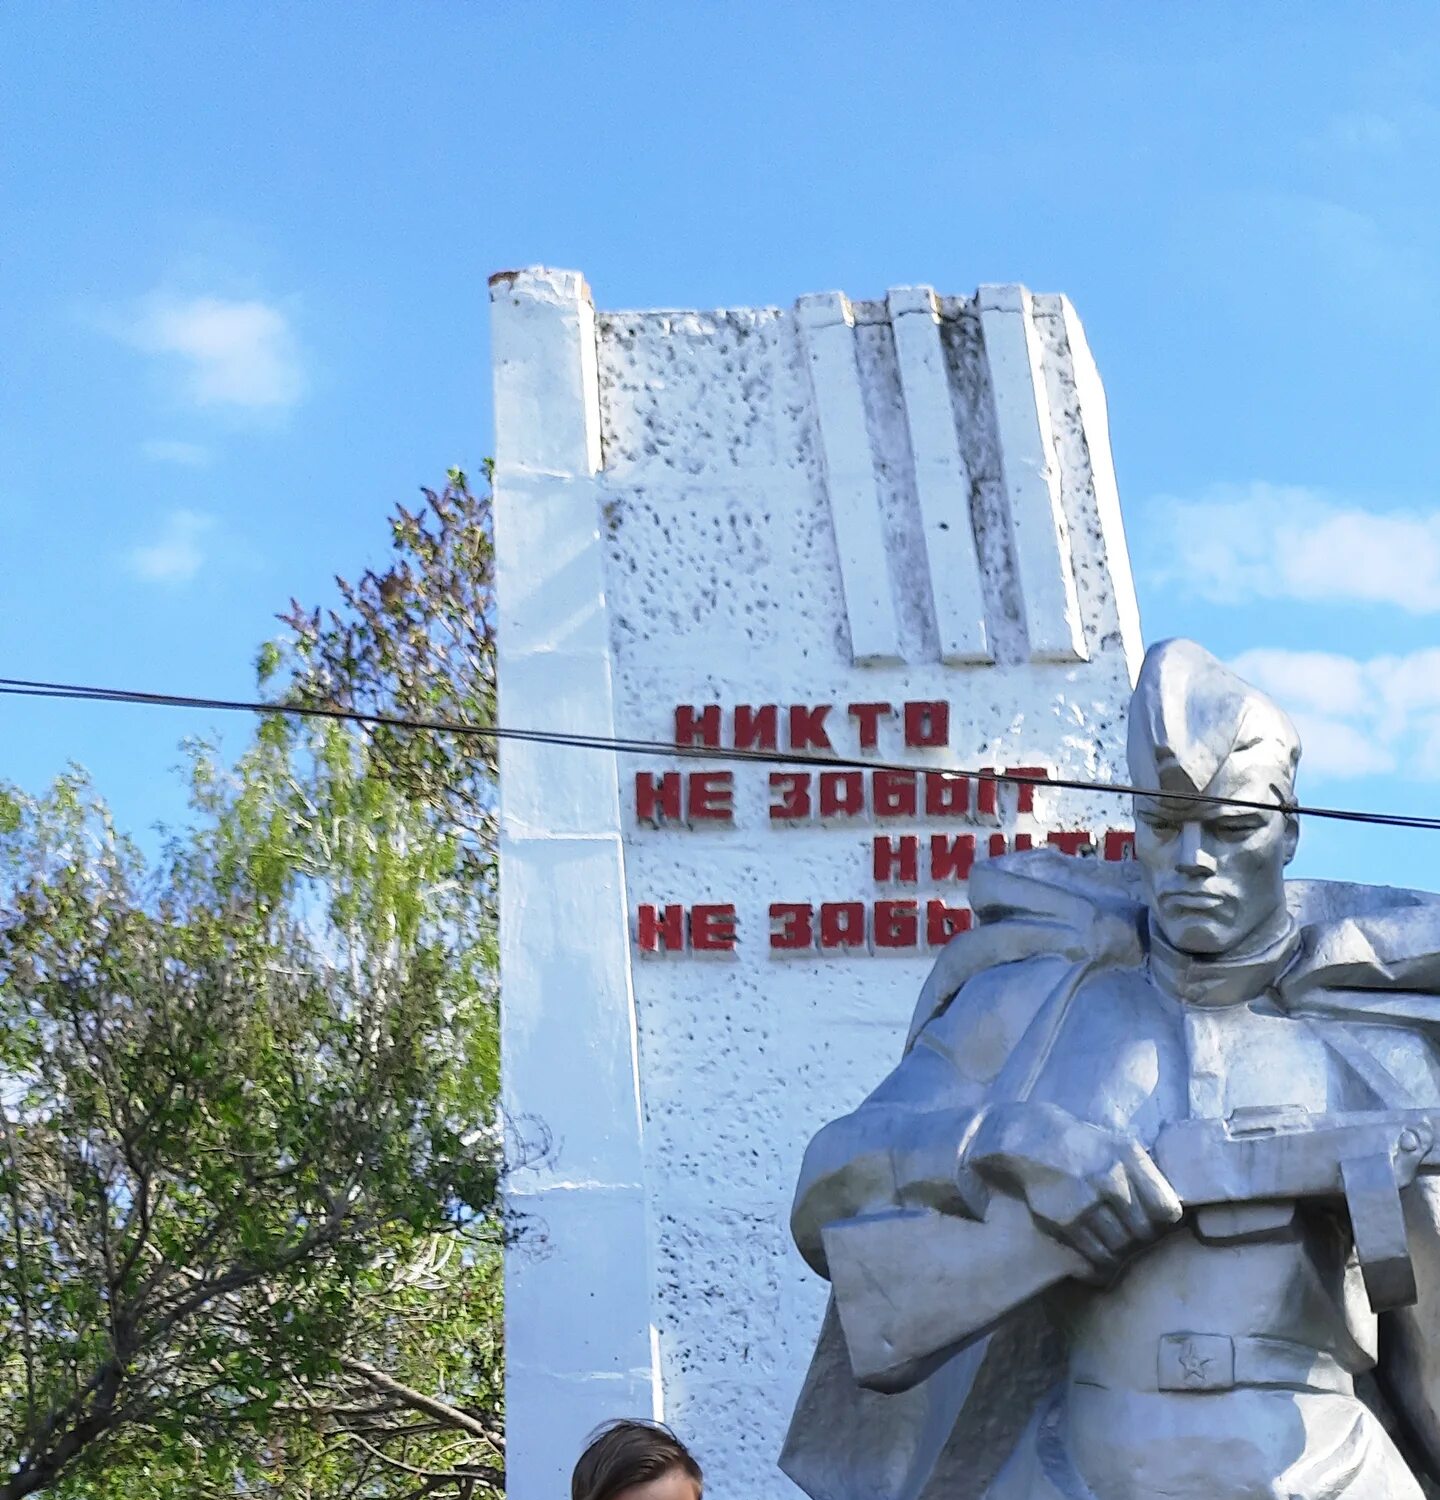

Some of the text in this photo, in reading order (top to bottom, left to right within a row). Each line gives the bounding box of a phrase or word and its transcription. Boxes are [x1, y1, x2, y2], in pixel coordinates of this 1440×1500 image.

[675, 701, 949, 749] НИКТО
[636, 767, 1047, 819] НЕ ЗАБЫТ
[638, 903, 736, 951] НЕ
